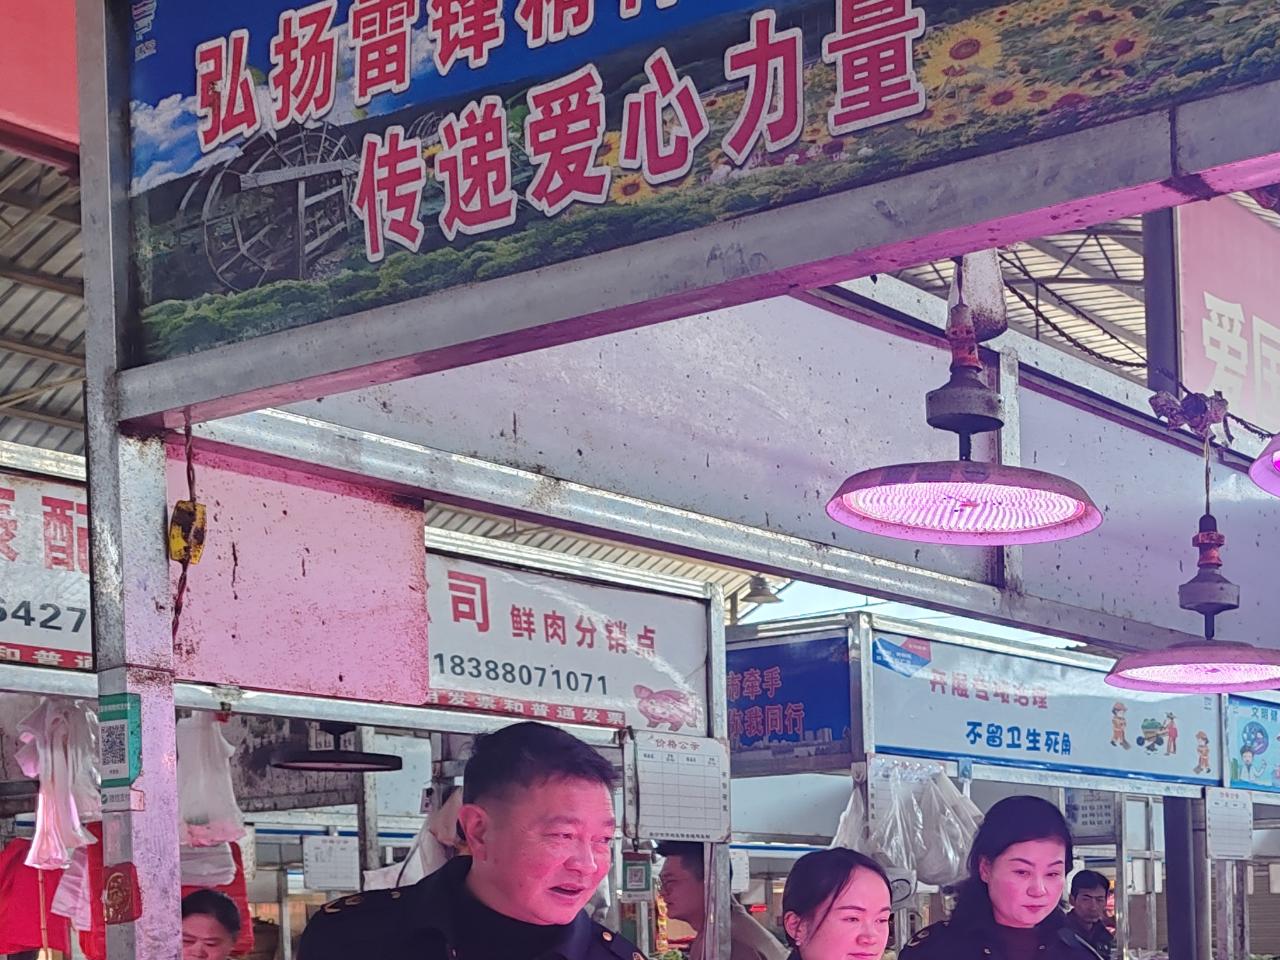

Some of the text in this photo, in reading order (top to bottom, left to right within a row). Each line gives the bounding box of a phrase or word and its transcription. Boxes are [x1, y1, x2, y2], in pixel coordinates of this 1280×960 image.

[195, 0, 680, 153] 弘扬雷锋
[354, 0, 926, 261] 传递爱心力量
[428, 569, 657, 658] 司 鲜肉分销点
[433, 652, 608, 696] 18388071071
[965, 720, 1072, 756] 不留卫生死角
